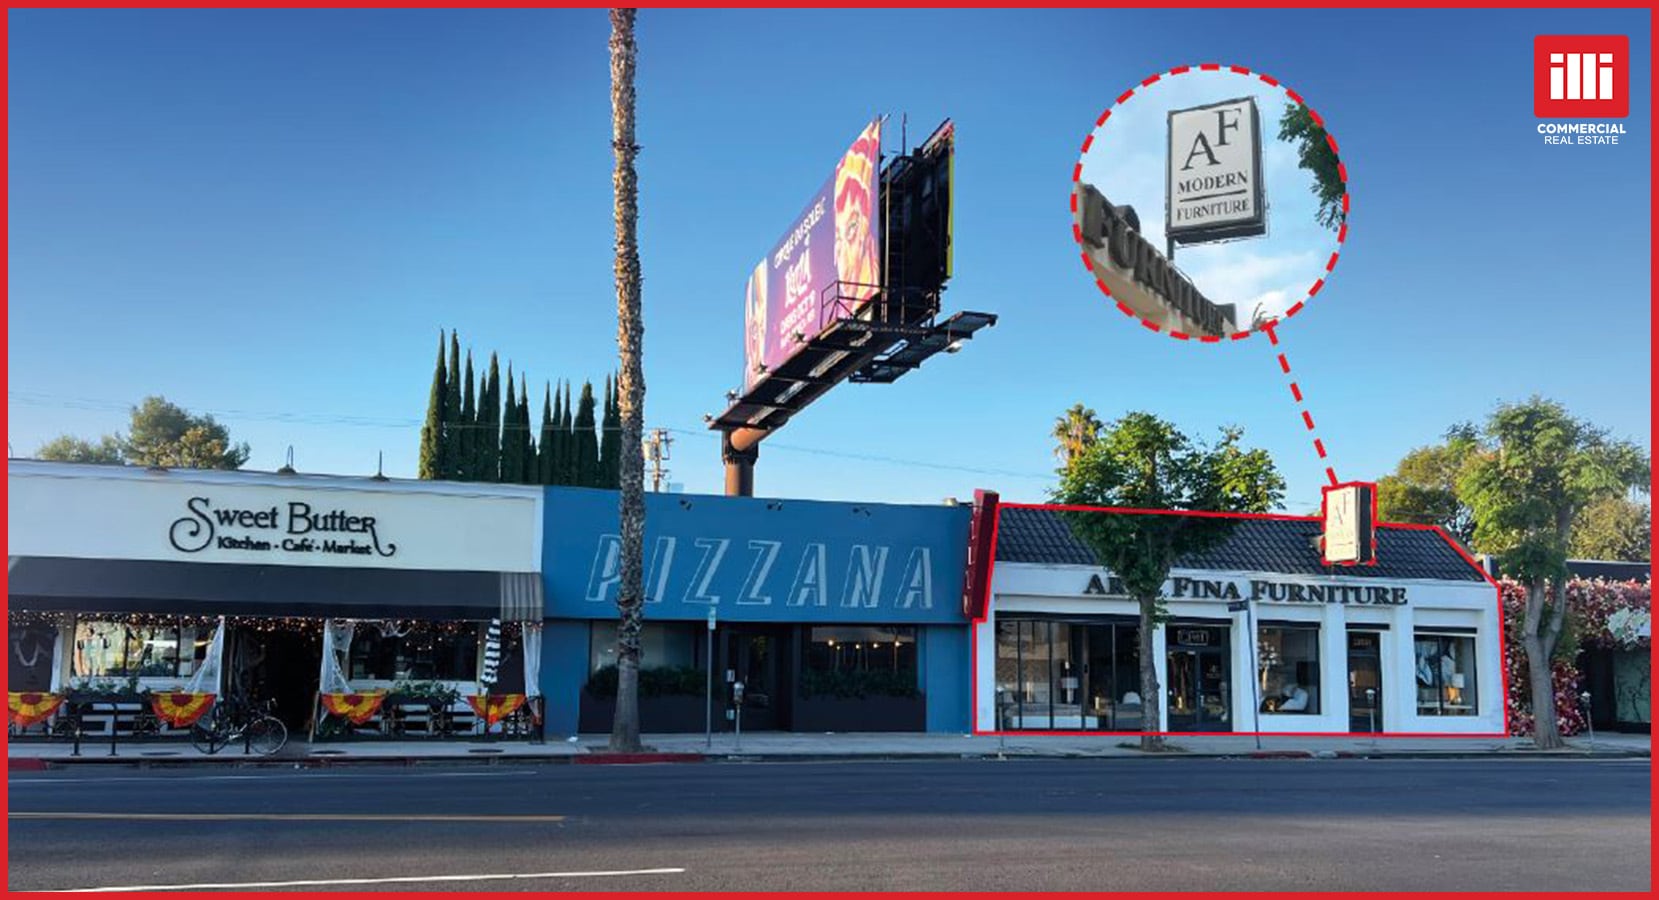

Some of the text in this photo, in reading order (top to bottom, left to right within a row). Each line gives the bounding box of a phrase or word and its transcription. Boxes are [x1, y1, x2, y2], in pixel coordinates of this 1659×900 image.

[1177, 170, 1248, 194] MODERN
[1176, 199, 1250, 221] FURNITURE
[170, 497, 279, 552] Sweet
[217, 536, 372, 555] Kitchen Café Market
[586, 534, 932, 609] PIZZANA
[1172, 576, 1241, 600] FINA
[1250, 580, 1408, 605] FURNITURE
